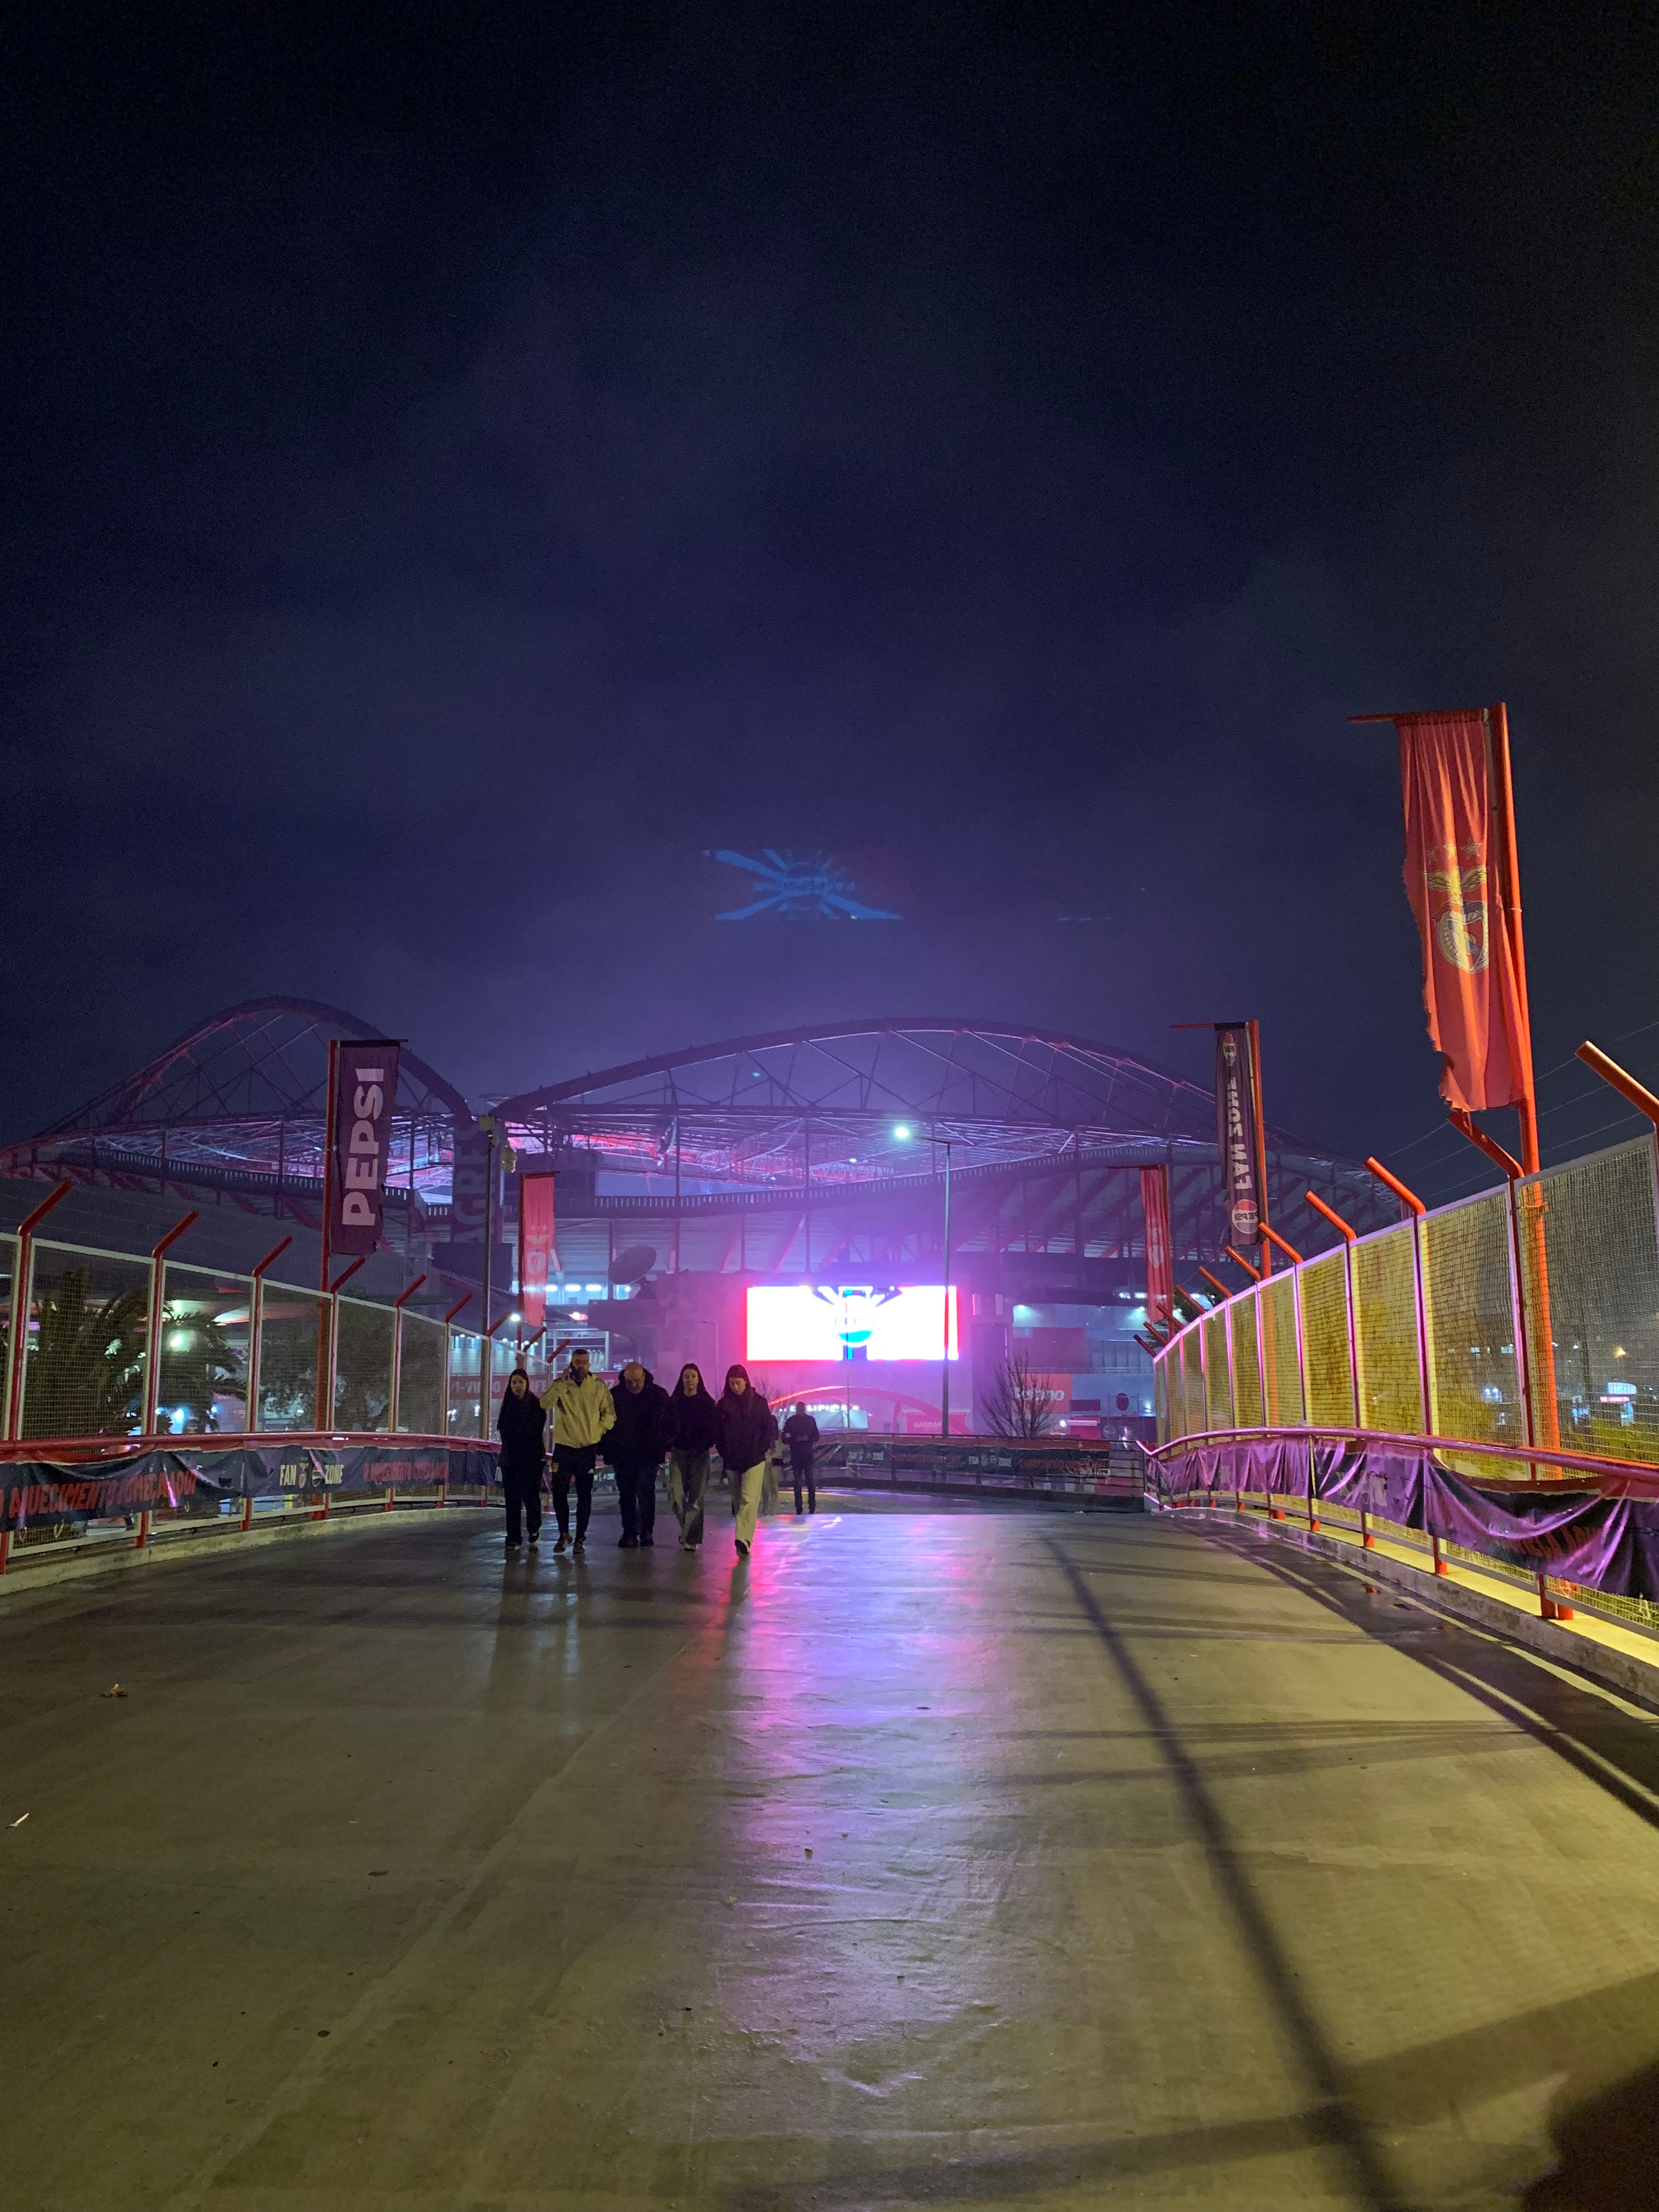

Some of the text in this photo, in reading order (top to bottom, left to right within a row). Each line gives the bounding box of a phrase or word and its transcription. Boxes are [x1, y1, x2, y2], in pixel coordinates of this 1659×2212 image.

[341, 1068, 384, 1226] PEPSI
[280, 1464, 344, 1486] FAN ZONE
